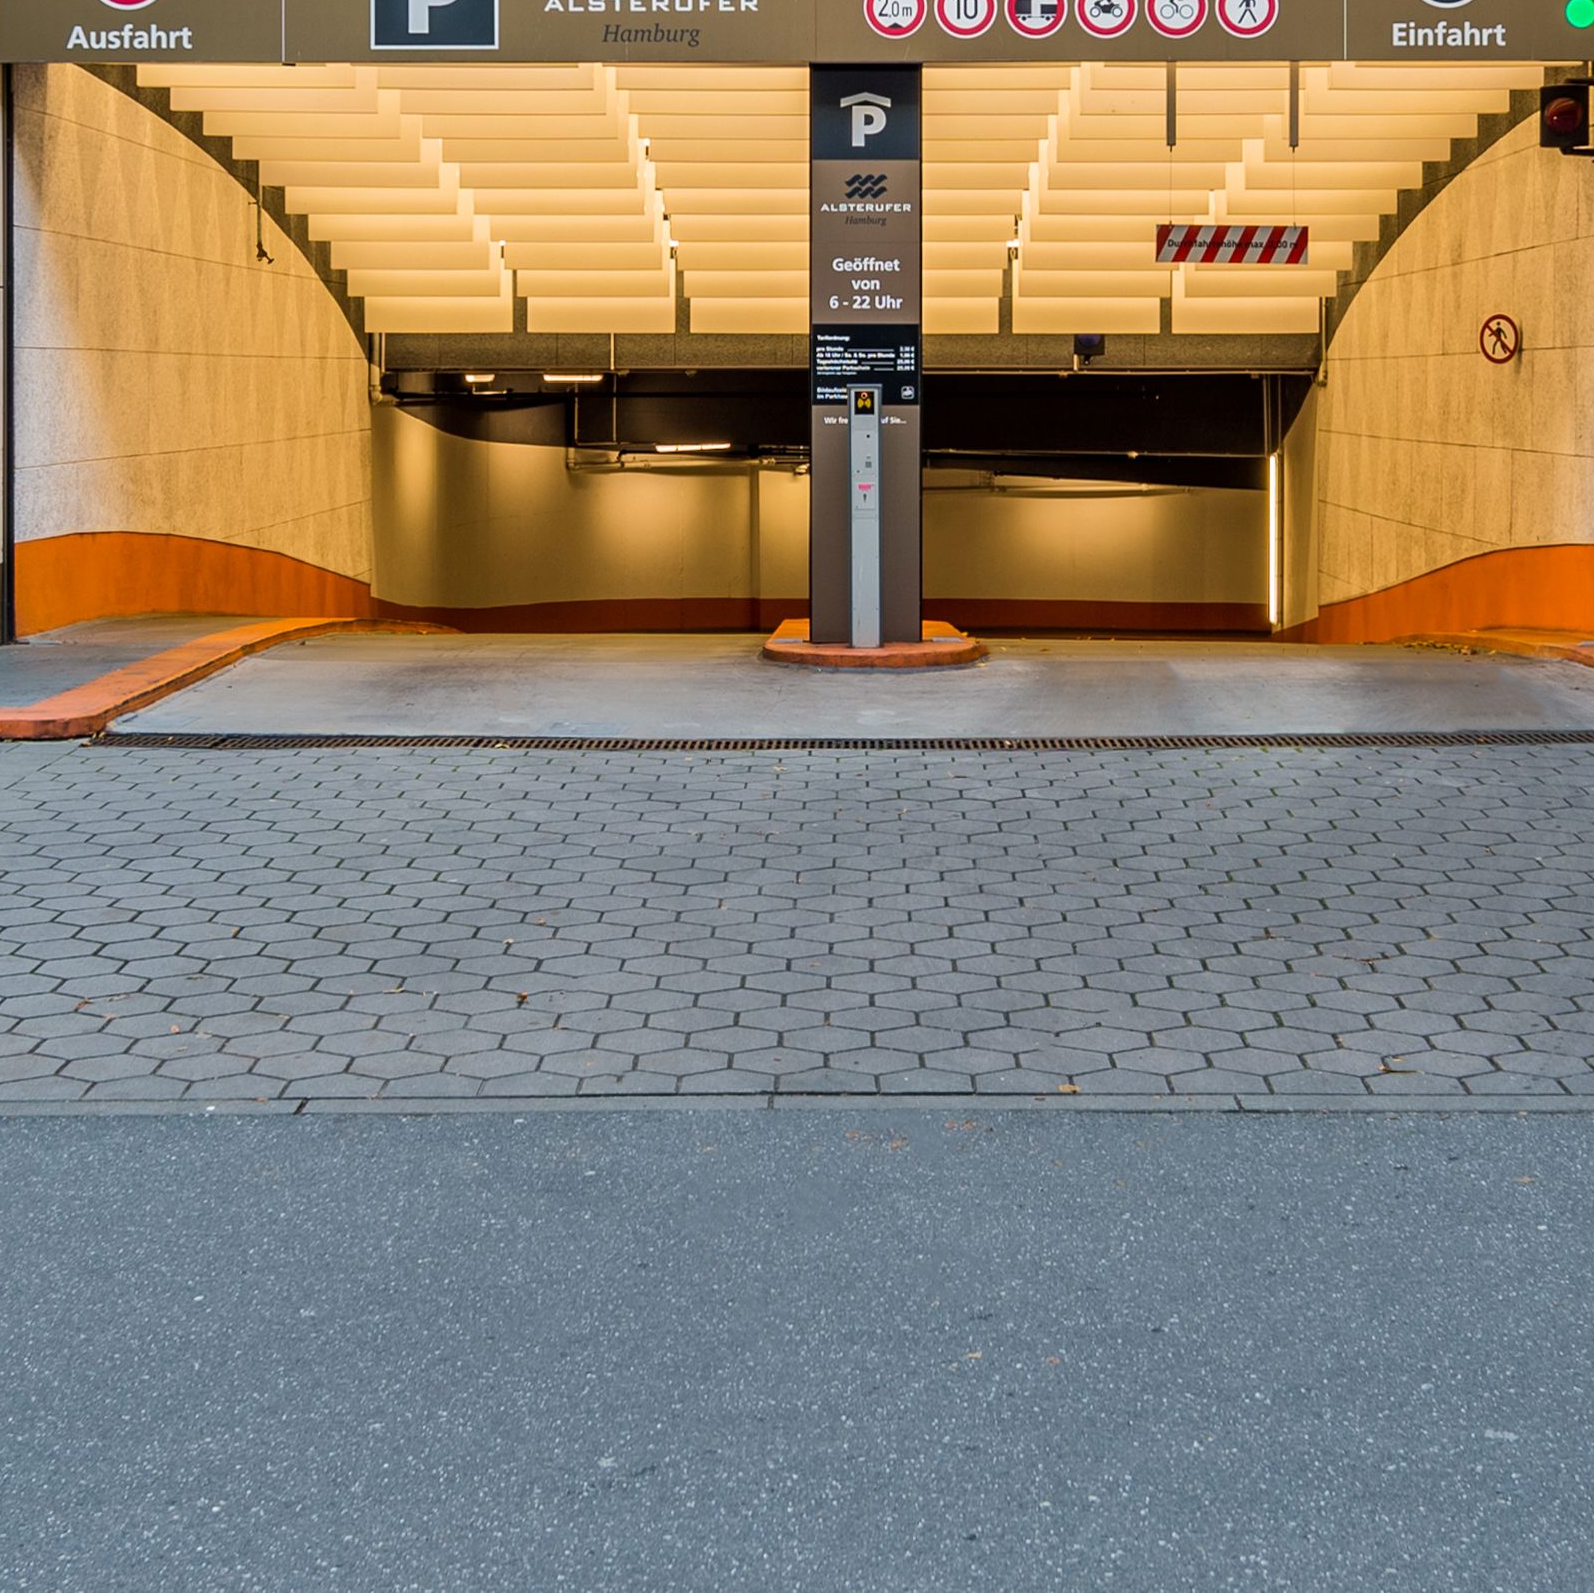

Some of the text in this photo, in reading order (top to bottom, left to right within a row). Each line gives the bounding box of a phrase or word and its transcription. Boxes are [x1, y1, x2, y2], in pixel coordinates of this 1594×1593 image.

[67, 24, 192, 50] Ausfahrt
[602, 23, 700, 48] Hamburg
[1391, 22, 1506, 47] Einfahrt
[851, 106, 887, 147] P
[821, 203, 911, 212] ALSTERUFER
[845, 216, 887, 227] Hamburg
[832, 257, 900, 272] Geöffnet
[851, 279, 880, 290] von
[829, 296, 838, 309] 6
[853, 296, 871, 309] 22
[875, 296, 903, 309] Uhr
[824, 416, 837, 424] Wir
[838, 416, 848, 424] fre
[880, 416, 889, 424] uf
